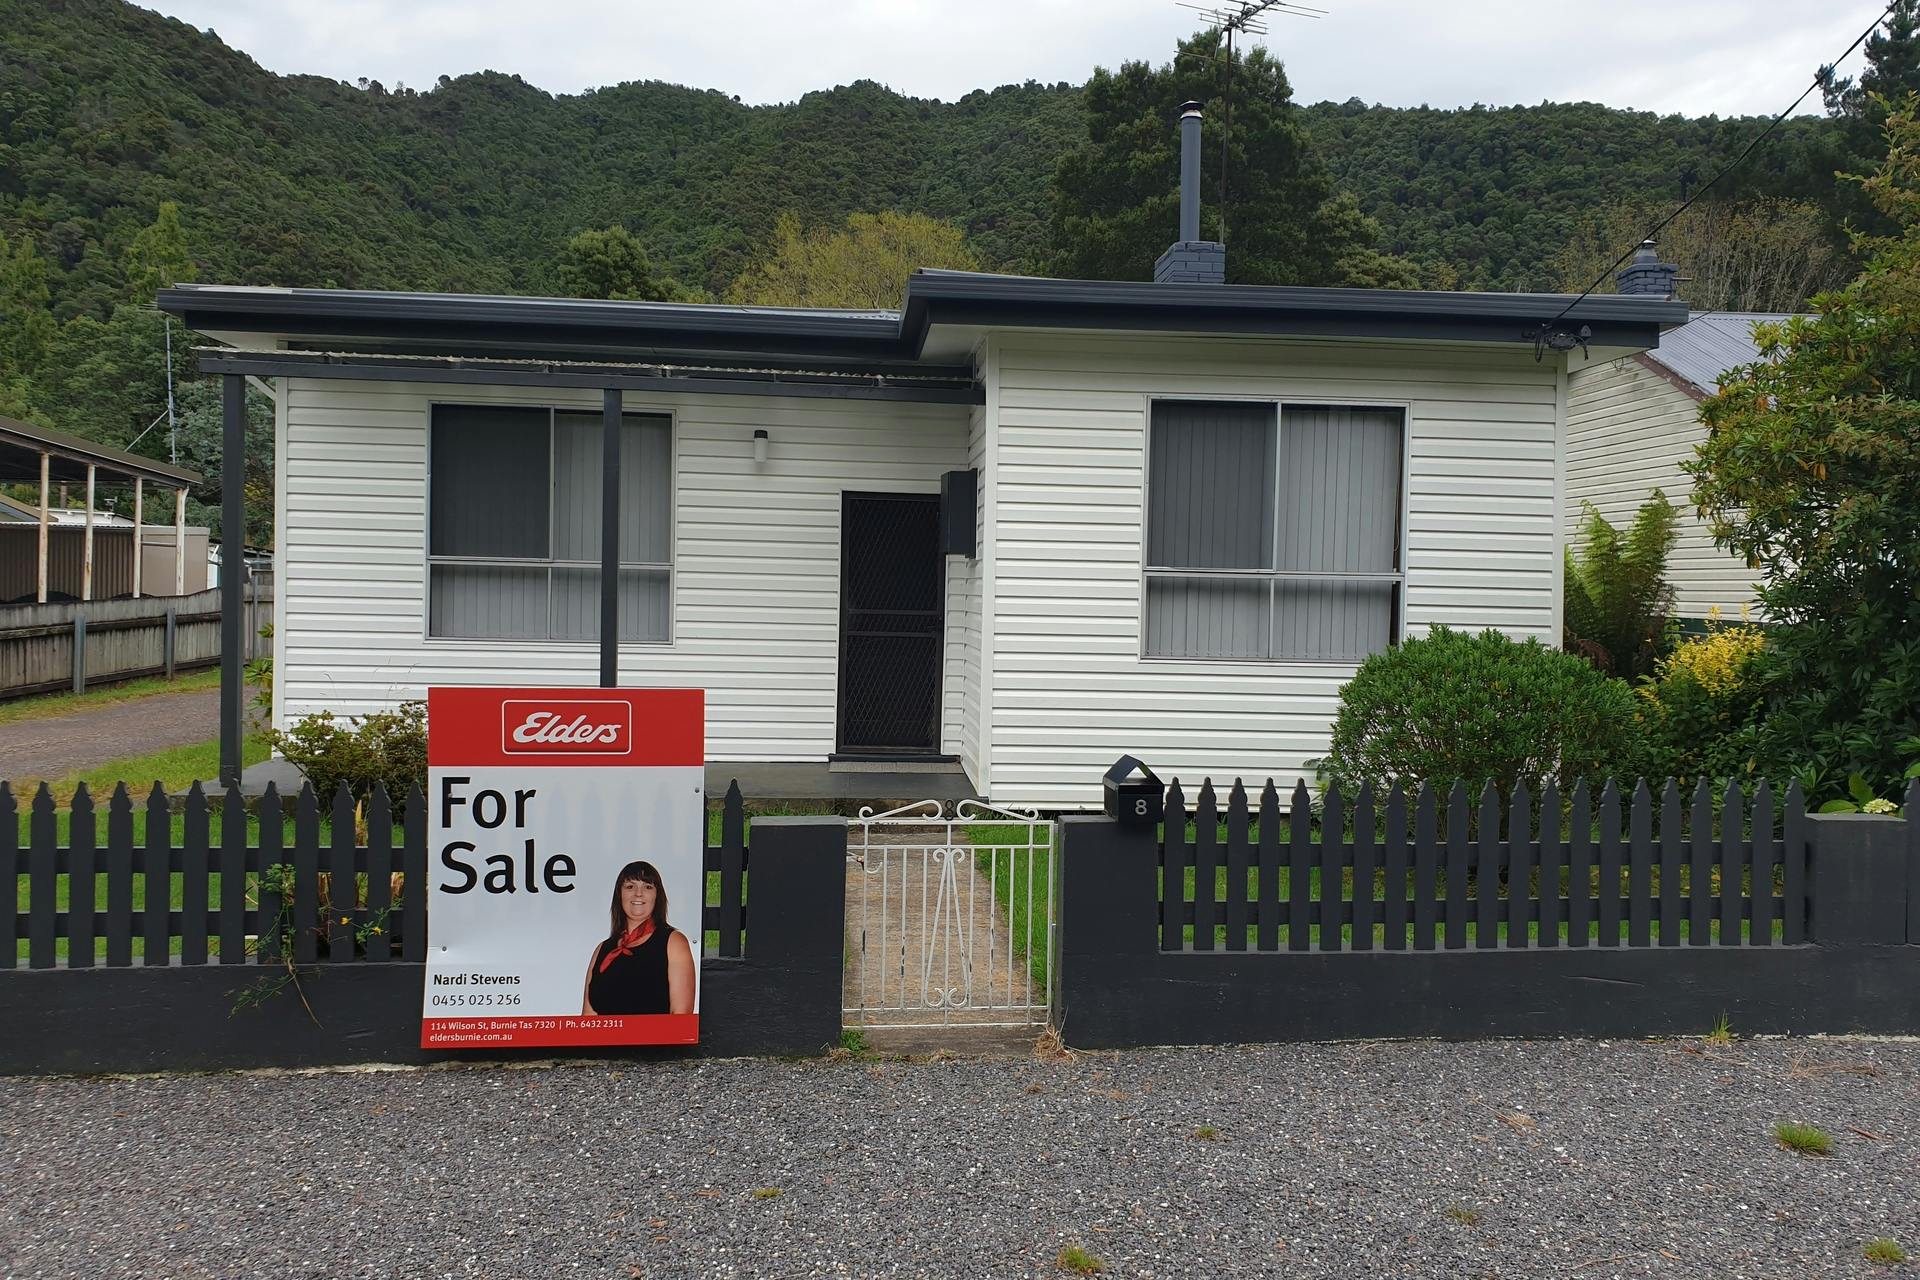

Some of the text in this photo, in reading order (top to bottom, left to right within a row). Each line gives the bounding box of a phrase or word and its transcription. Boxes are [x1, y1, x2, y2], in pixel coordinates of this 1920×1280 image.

[512, 711, 622, 744] Elders
[441, 776, 537, 829] For
[1135, 799, 1148, 816] 8
[439, 838, 577, 895] Sale
[433, 973, 521, 985] Nardi Stevens
[432, 994, 521, 1006] 0455 025 256
[431, 1020, 624, 1030] 114 Wilson St, Burnie Tas 7320 Ph. 6432 2311
[429, 1033, 513, 1042] eldersburnie.com.au
